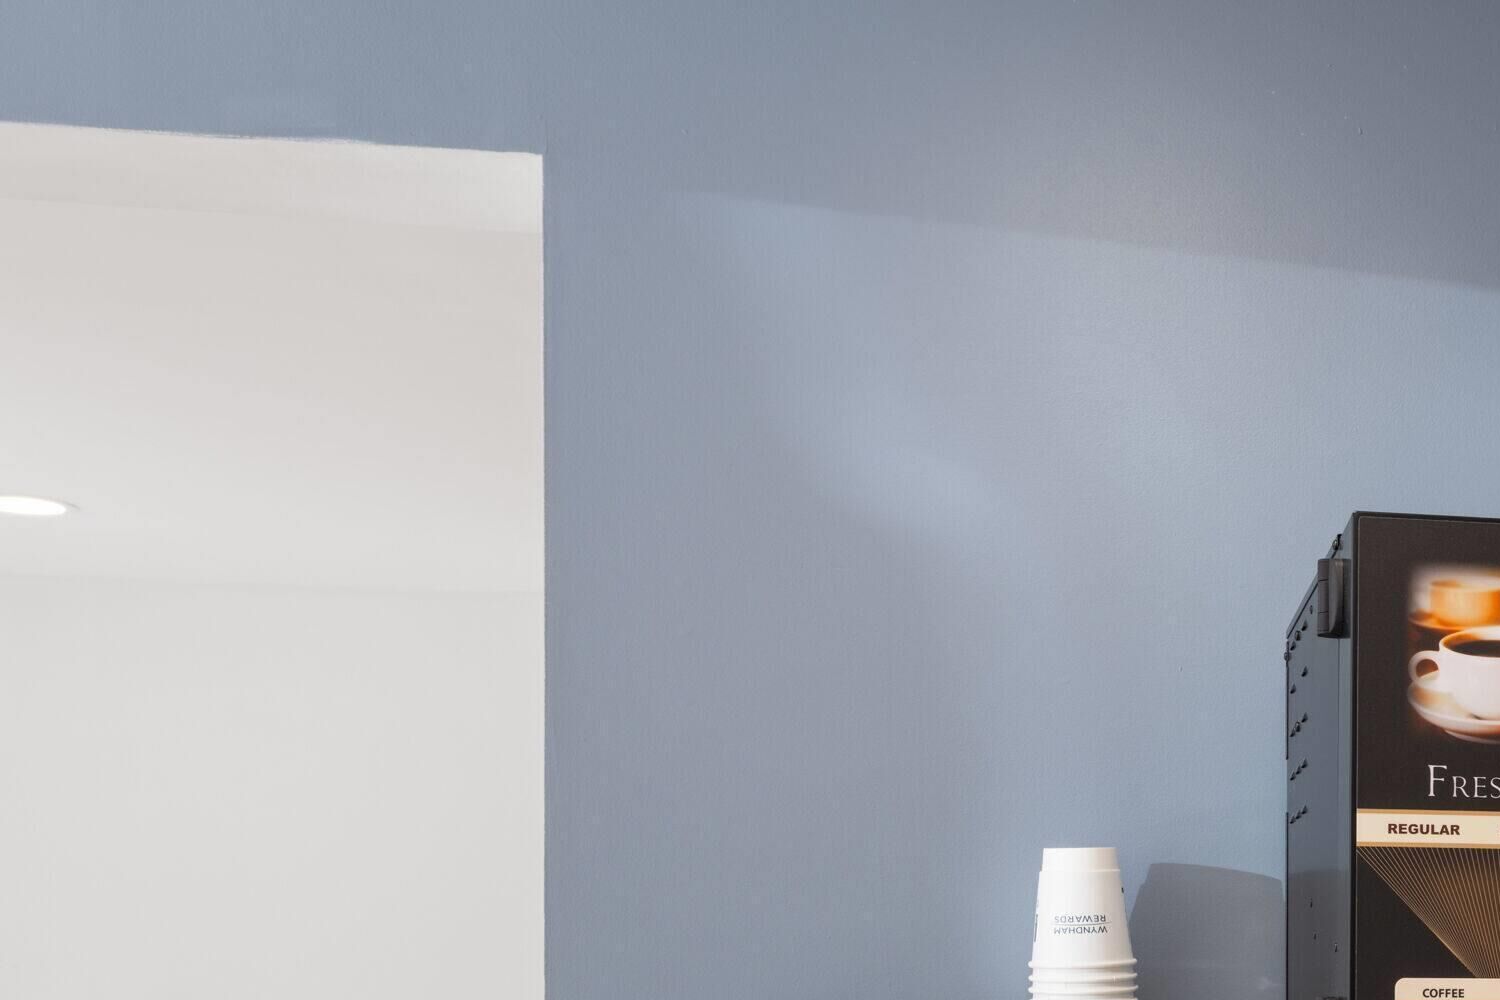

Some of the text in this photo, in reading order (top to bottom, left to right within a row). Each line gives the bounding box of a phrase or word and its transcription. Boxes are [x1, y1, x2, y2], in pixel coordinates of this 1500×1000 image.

[1387, 823, 1461, 836] REGULAR
[1054, 914, 1107, 923] REWARDS
[1053, 925, 1108, 935] WYNDHAM
[1422, 988, 1465, 999] COFFEE
